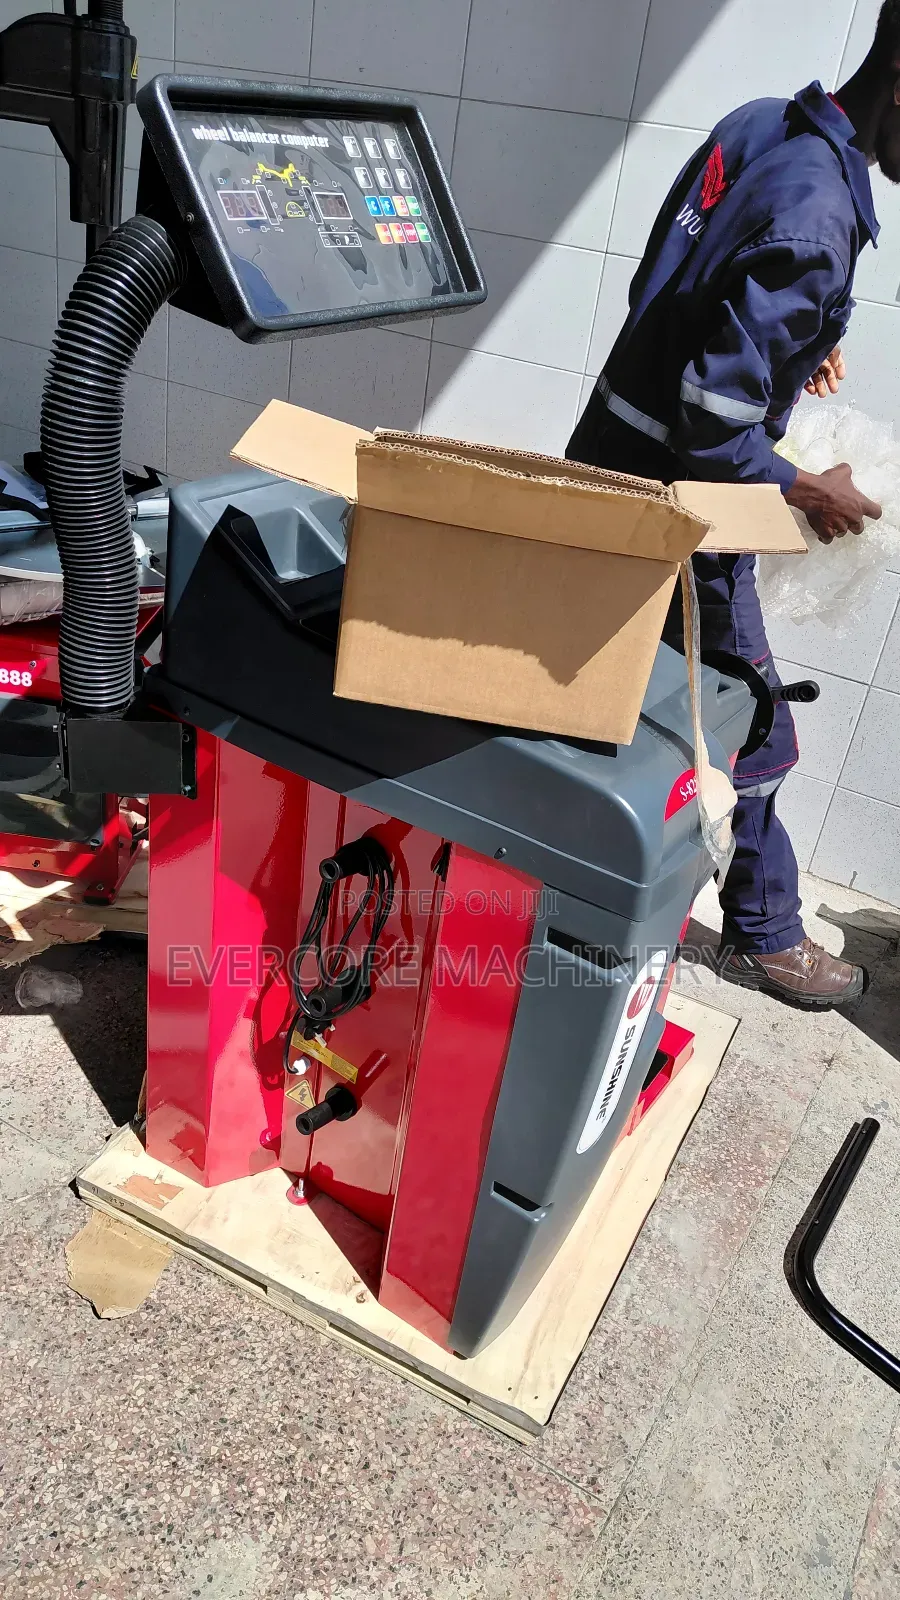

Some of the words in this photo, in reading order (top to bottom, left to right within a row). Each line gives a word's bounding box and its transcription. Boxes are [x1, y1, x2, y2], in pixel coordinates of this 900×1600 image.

[191, 124, 231, 141] wheel
[228, 126, 281, 145] balancer
[280, 134, 330, 149] computer
[595, 1024, 637, 1121] SUNSHINE
